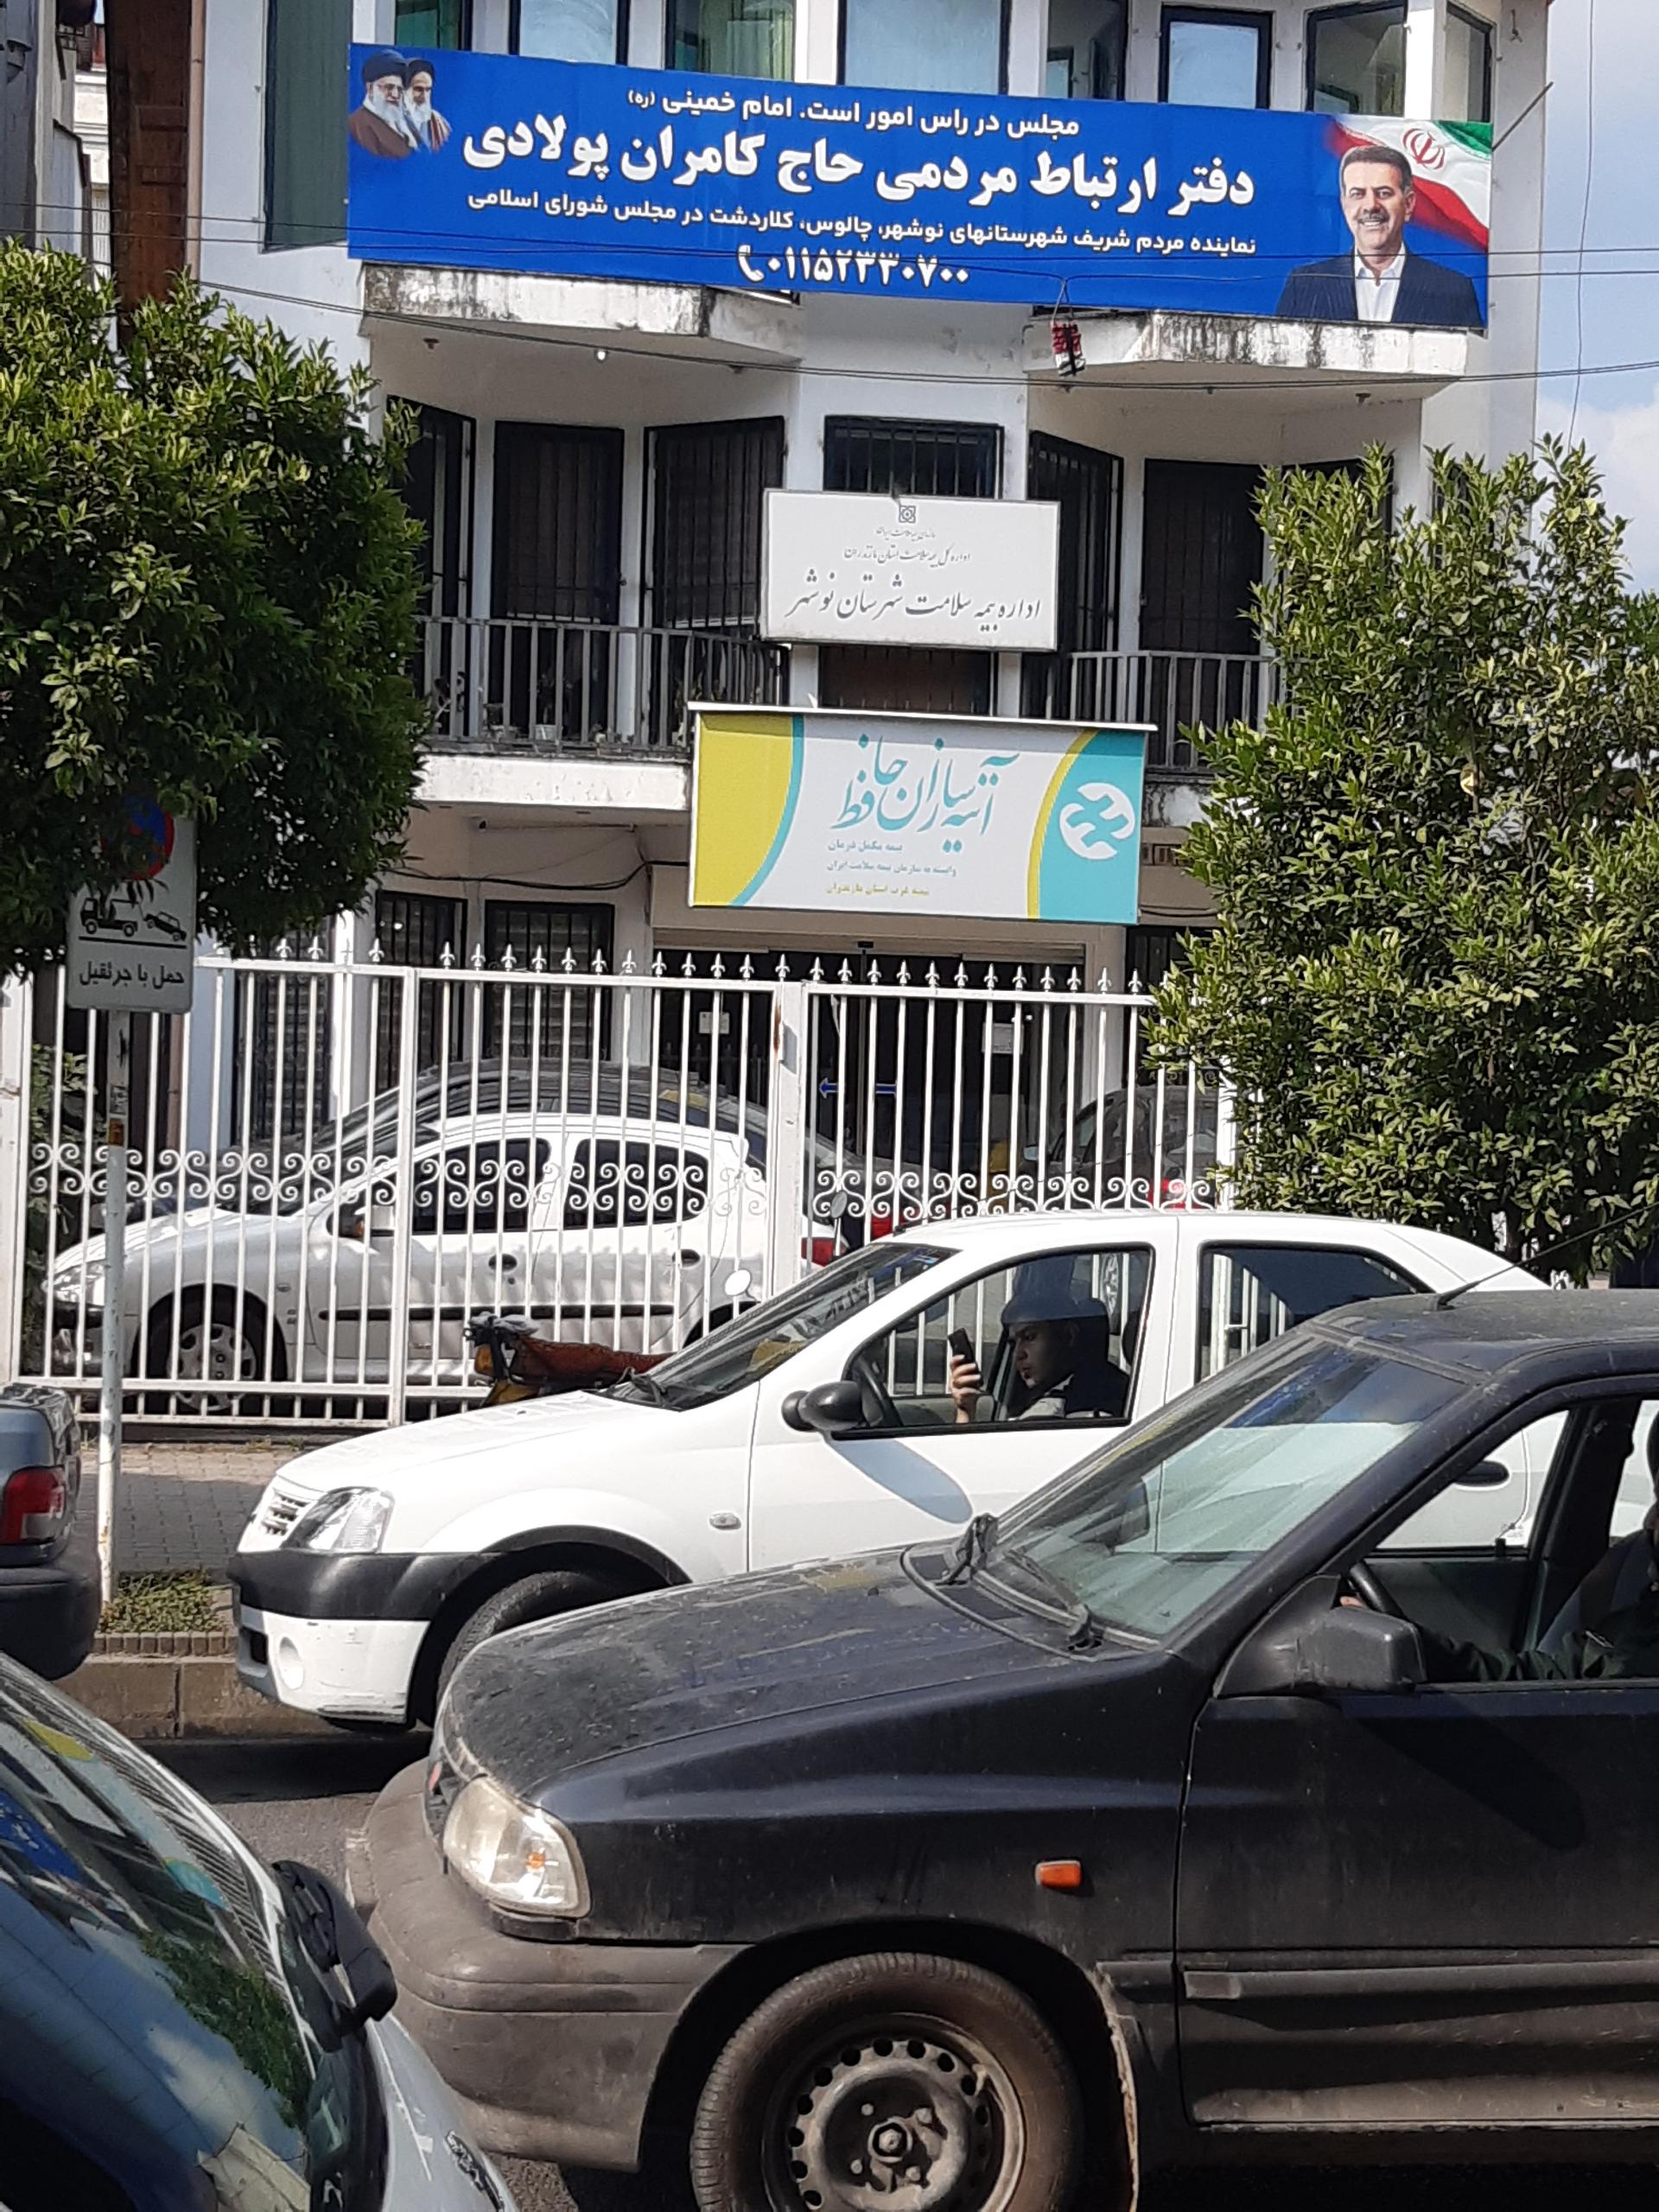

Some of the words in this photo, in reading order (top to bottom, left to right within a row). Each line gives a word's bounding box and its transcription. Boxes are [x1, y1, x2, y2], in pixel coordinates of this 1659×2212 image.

[627, 89, 656, 109] (ره)
[662, 91, 735, 116] خمینی
[742, 95, 792, 120] امام
[799, 101, 861, 123] است.
[866, 105, 913, 131] امور
[920, 109, 968, 136] راس
[974, 115, 1000, 137] در
[1007, 113, 1079, 140] مجلس
[463, 114, 610, 181] پولادی
[620, 124, 766, 187] کامران
[777, 137, 863, 194] حاج
[875, 156, 1018, 207] مردمی
[1029, 150, 1157, 214] ارتباط
[1167, 156, 1255, 217] دفتر
[467, 188, 539, 210] اسلامی
[544, 191, 608, 217] شورای
[613, 200, 677, 223] مجلس
[681, 207, 704, 226] در
[709, 206, 794, 232] کلاردشت
[949, 222, 1068, 249] شهرستانهای
[1073, 228, 1131, 252] شریف
[1135, 234, 1185, 255] مردم
[1190, 235, 1256, 257] نماینده
[767, 245, 969, 288] ۰۱۱۵۲۳۳۰۷۰۰
[784, 568, 835, 619] نوشهر
[836, 573, 904, 621] شهرستان
[905, 592, 972, 618] سلامت
[973, 602, 999, 632] بیمه
[997, 598, 1041, 620] اداره
[830, 733, 909, 830] حافظ
[875, 737, 976, 832] سازان
[940, 752, 1021, 854] آتیه
[828, 838, 856, 853] درمان
[858, 839, 883, 853] مکمل
[79, 960, 133, 987] جرثقیل
[137, 963, 149, 988] با
[152, 964, 185, 989] حمل
